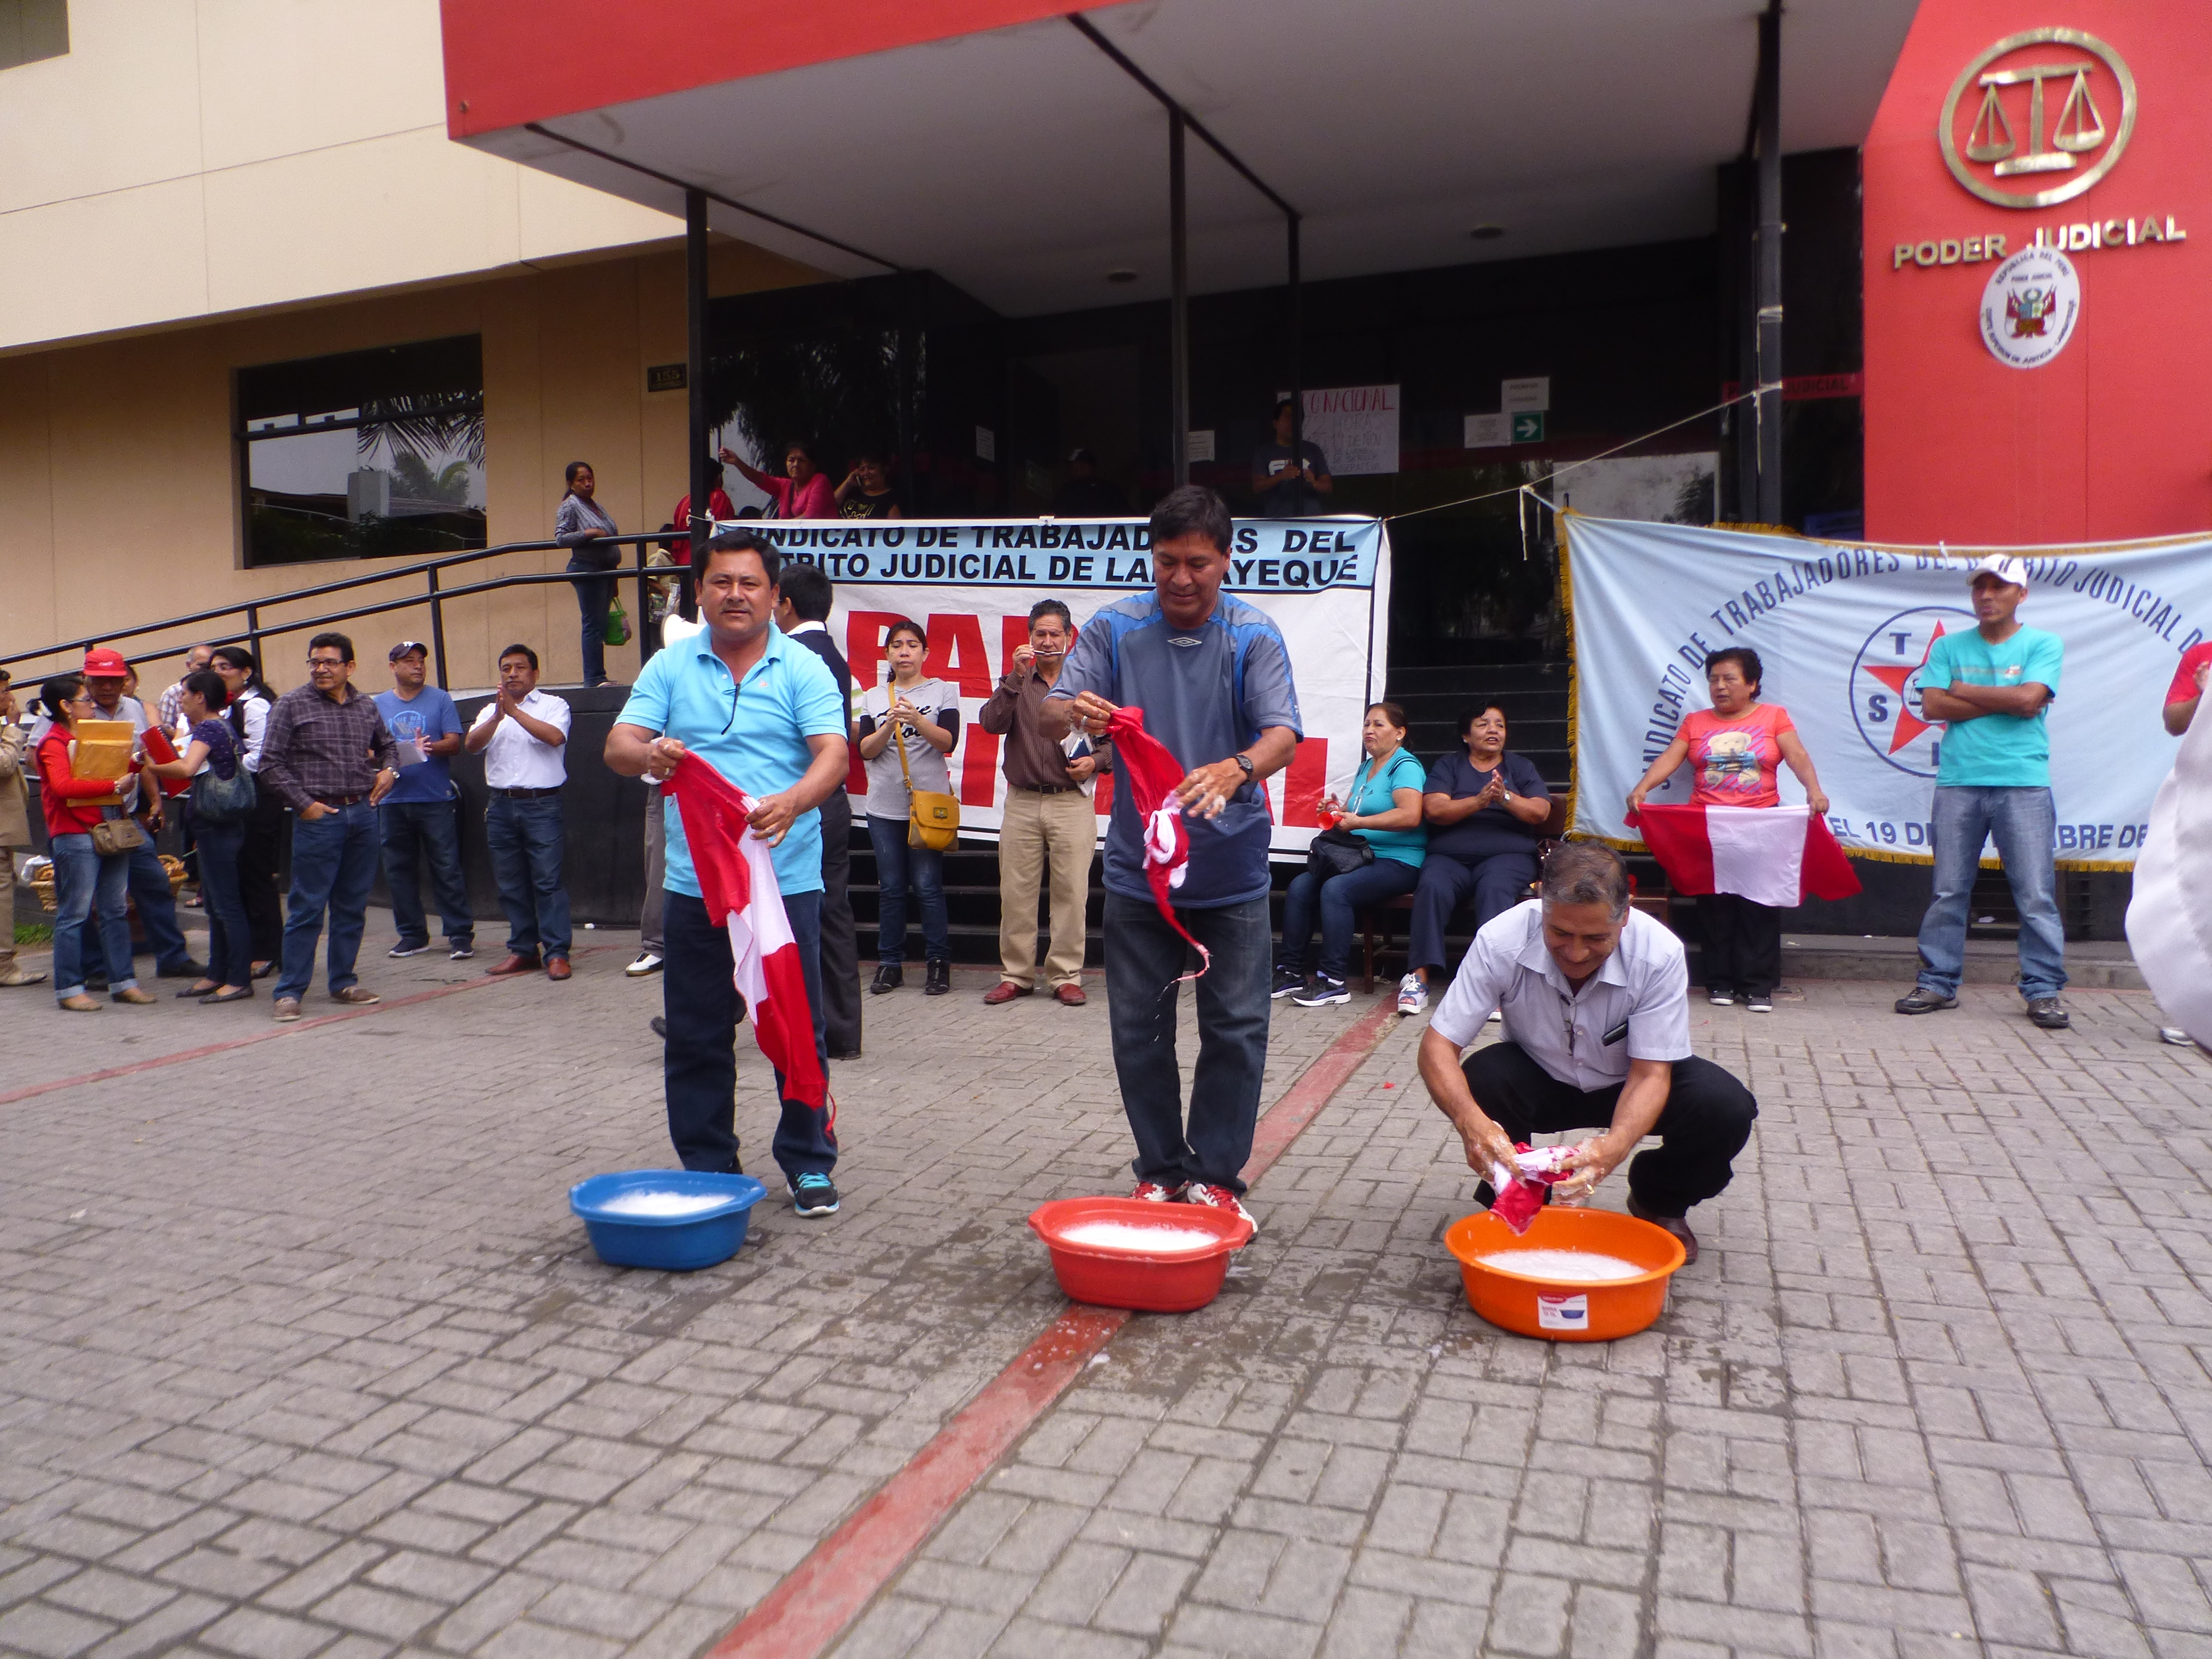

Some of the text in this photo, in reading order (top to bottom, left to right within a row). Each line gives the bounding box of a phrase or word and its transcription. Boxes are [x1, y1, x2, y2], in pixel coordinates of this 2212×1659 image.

[1894, 214, 2187, 269] PODER JUDICIAL
[917, 527, 958, 547] DE
[971, 525, 1258, 554] TRABAJADS
[1282, 529, 1355, 553] DEL
[880, 554, 1036, 580] JUDICIAL
[1049, 556, 1094, 581] DE
[1678, 632, 1714, 670] DE
[1710, 547, 1900, 635] TRABAJADORES
[2074, 567, 2182, 642] JUDICIAL
[1889, 632, 1911, 655] T
[1868, 694, 1888, 722] S
[1828, 816, 1861, 838] EL
[1866, 821, 1897, 844] 19
